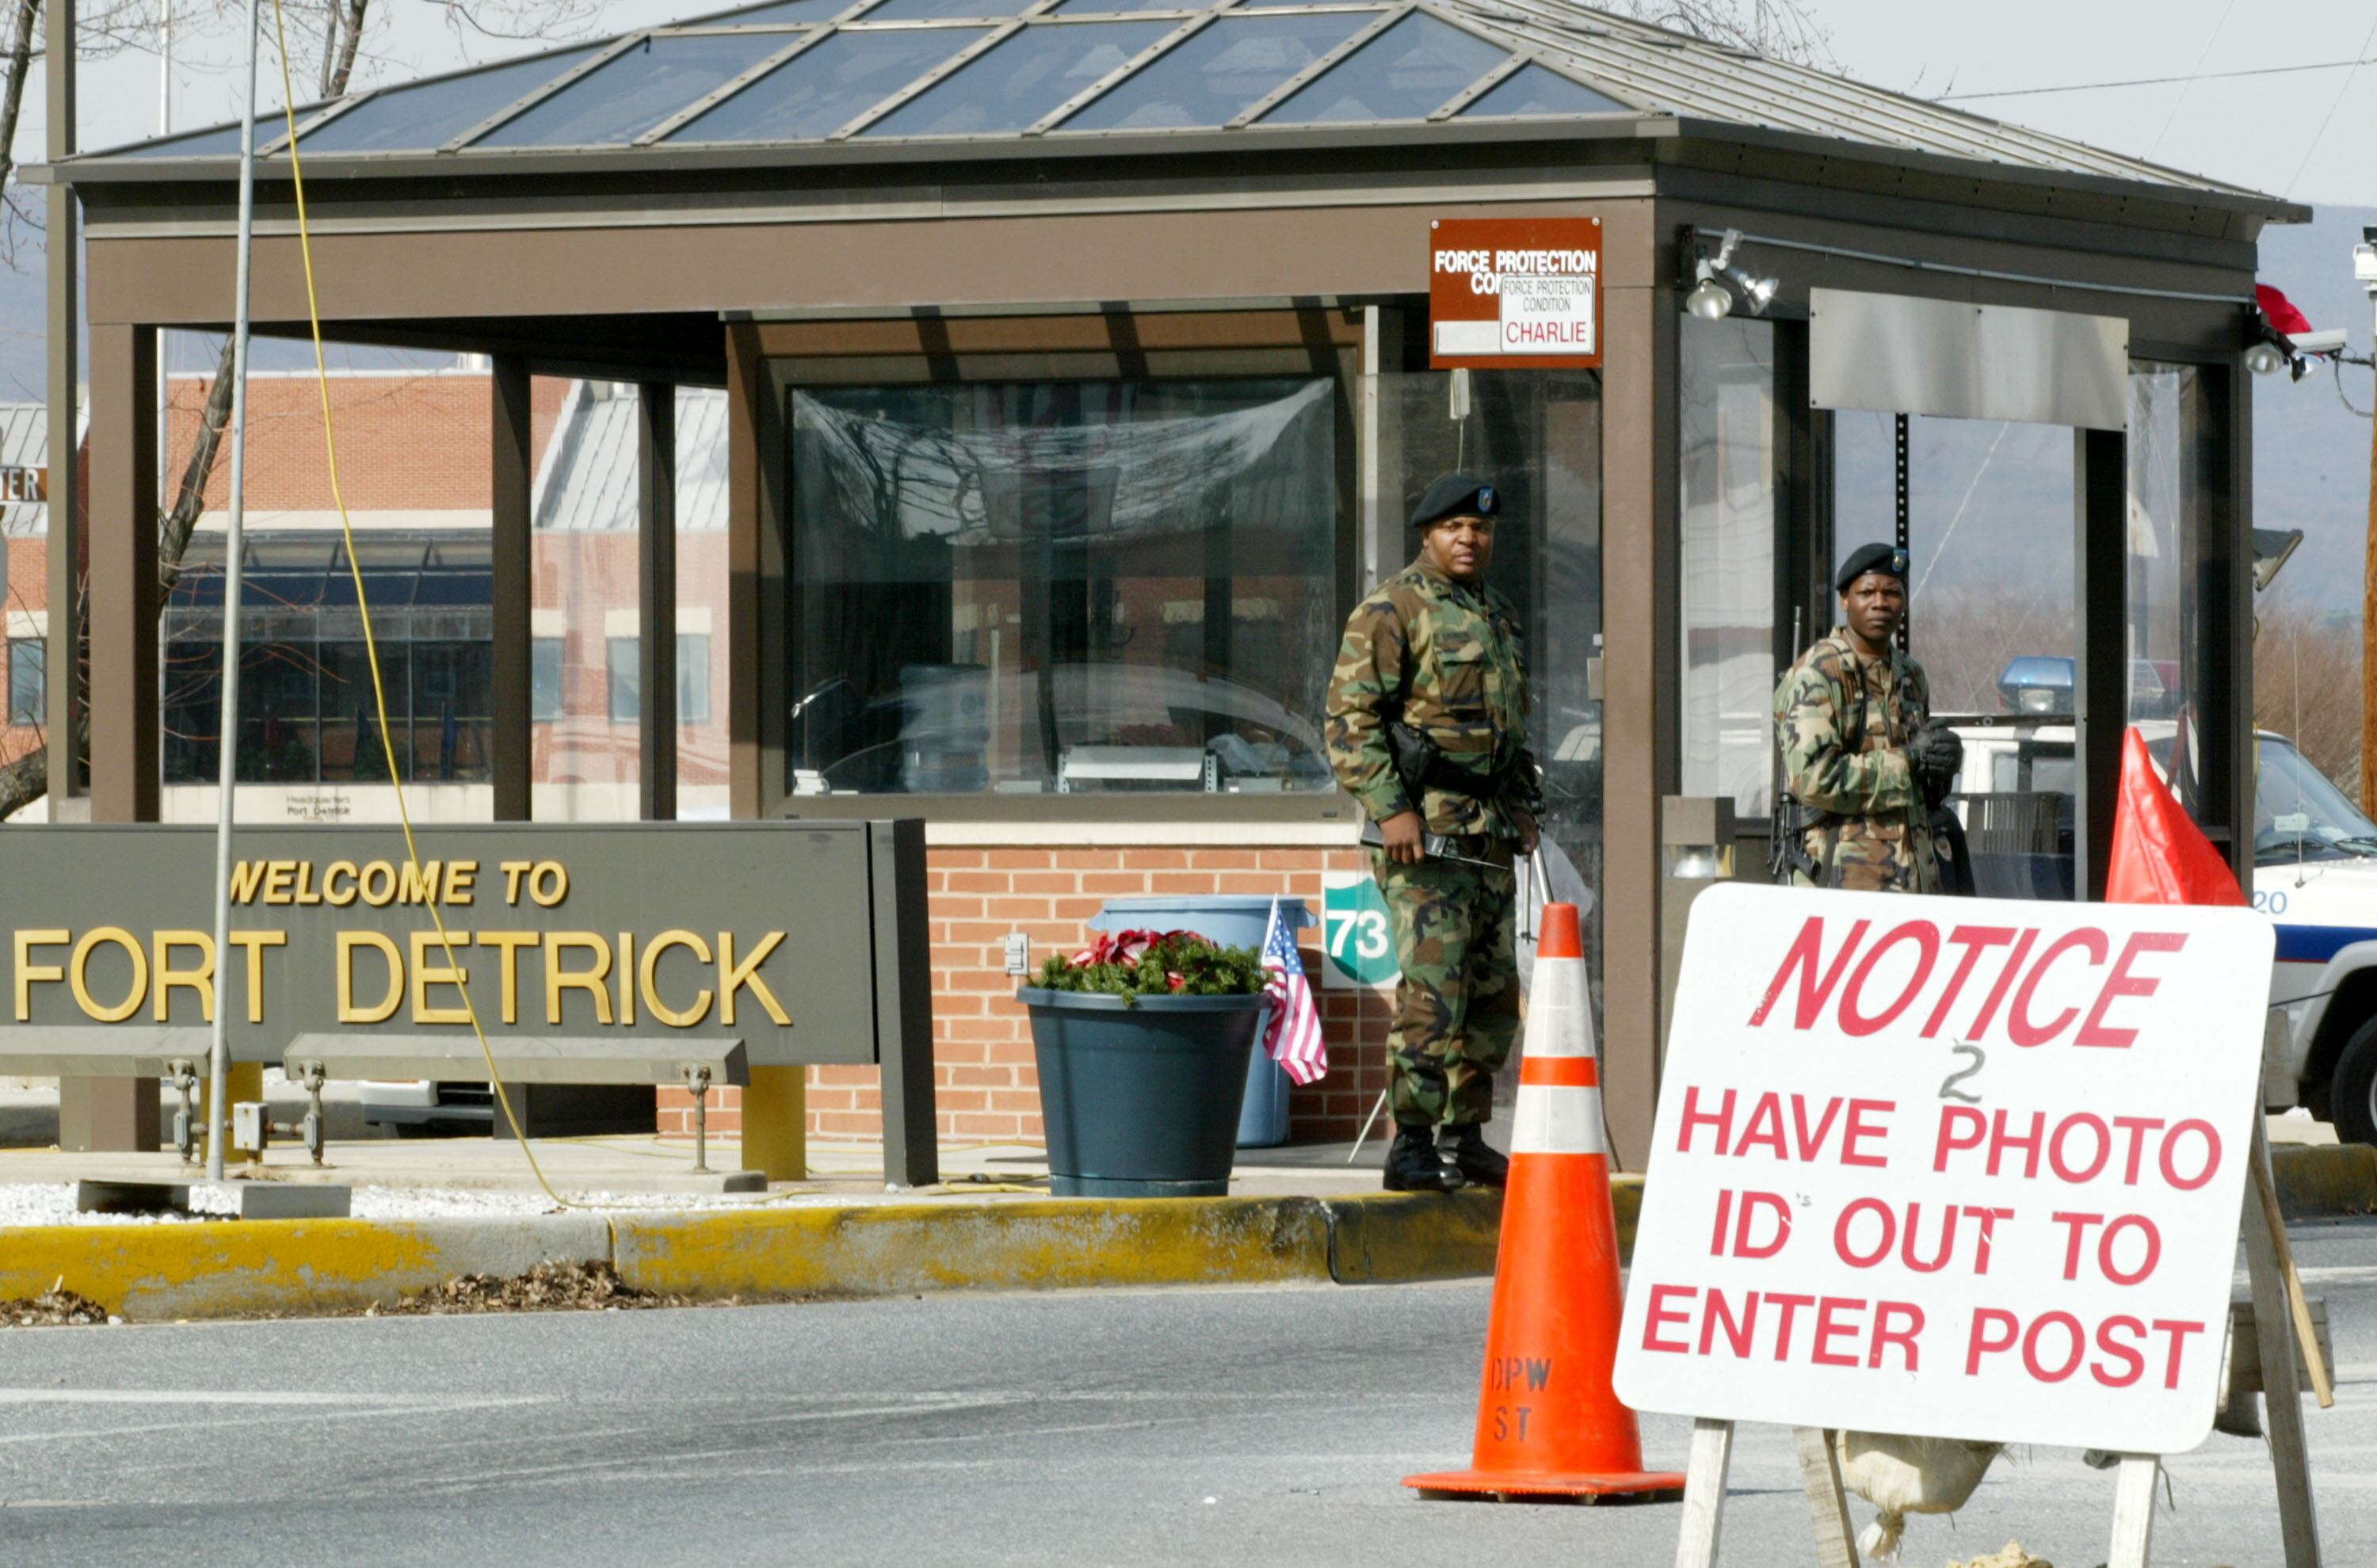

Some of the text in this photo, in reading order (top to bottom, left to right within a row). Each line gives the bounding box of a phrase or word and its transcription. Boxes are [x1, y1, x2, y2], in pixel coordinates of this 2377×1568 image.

[1434, 250, 1597, 273] FORCE PROTECTION
[1504, 280, 1534, 296] FORCE
[1536, 280, 1592, 296] PROTECTION
[1522, 296, 1572, 313] CONDITION
[1505, 321, 1586, 344] CHARLIE
[230, 860, 568, 907] WELCOME TO
[1326, 909, 1389, 959] 73
[14, 926, 792, 1028] FORT DETRICK
[1748, 916, 2190, 1048] NOTICE
[1938, 1044, 1986, 1104] 2
[1676, 1086, 2222, 1192] HAVE PHOTO
[1833, 1197, 2015, 1275] OUT
[2052, 1211, 2162, 1286] TO
[1642, 1284, 2205, 1390] ENTER POST
[1491, 1357, 1551, 1392] DPW
